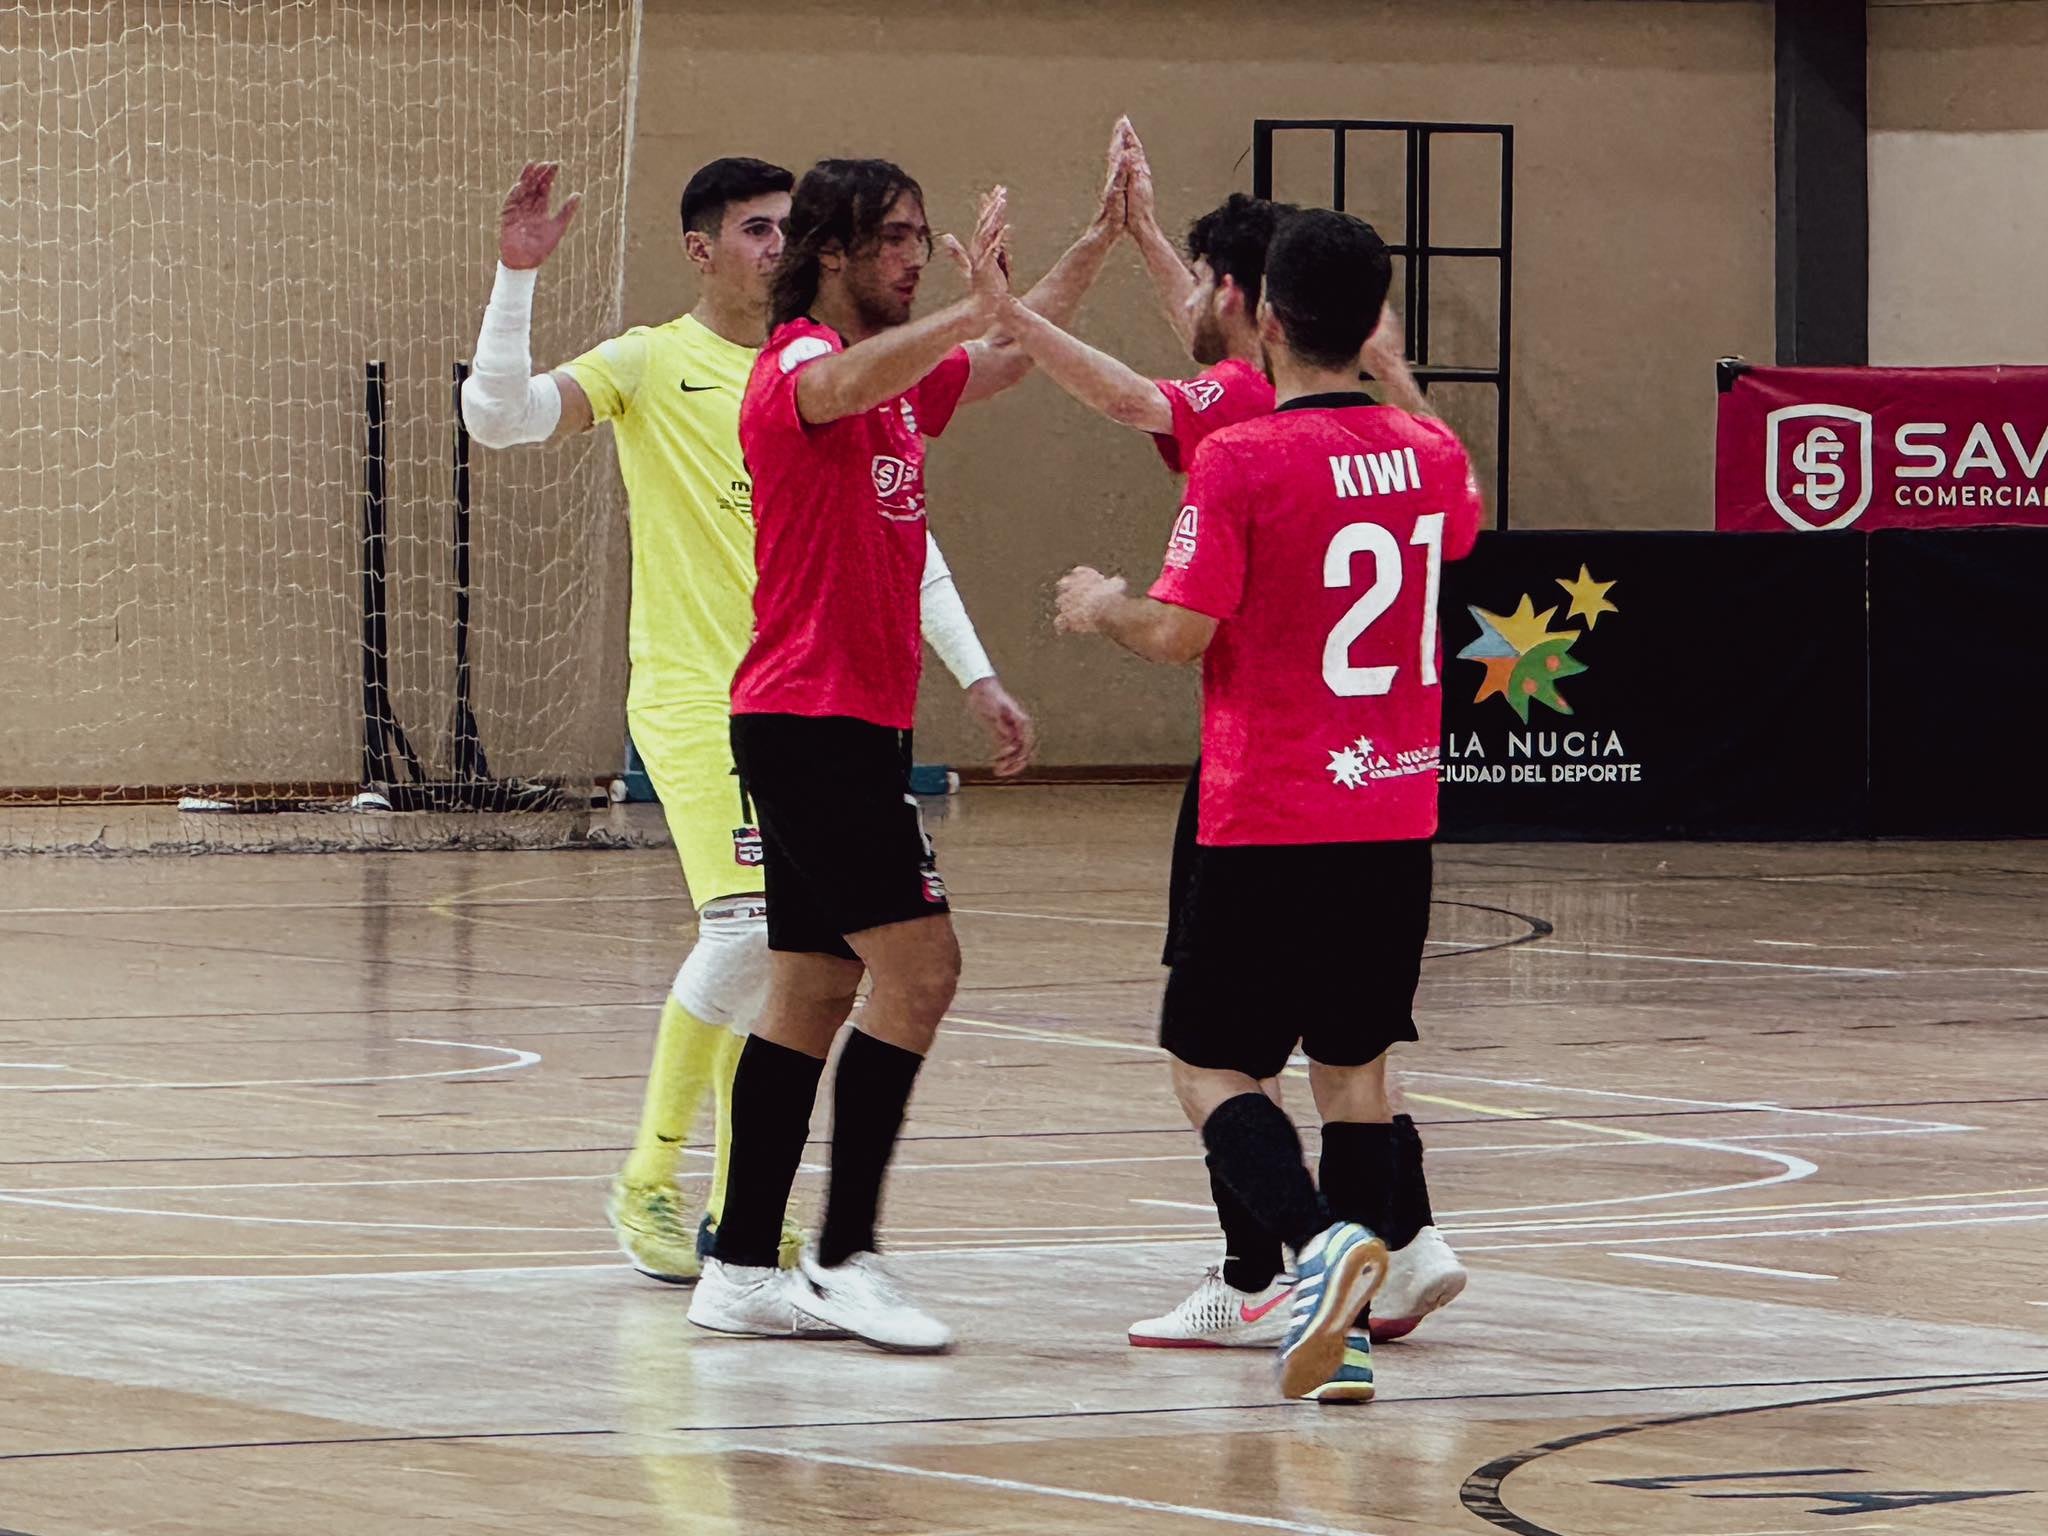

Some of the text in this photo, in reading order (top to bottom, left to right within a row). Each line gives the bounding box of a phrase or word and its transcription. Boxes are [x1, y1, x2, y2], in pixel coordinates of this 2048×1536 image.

[1895, 422, 2048, 479] SAV
[1329, 447, 1421, 498] KIWI
[1895, 485, 2048, 507] COMERCIA
[1322, 512, 1445, 697] 21
[1449, 731, 1486, 758] LA
[1511, 764, 1546, 783] DEL
[1552, 763, 1642, 783] DEPORTE
